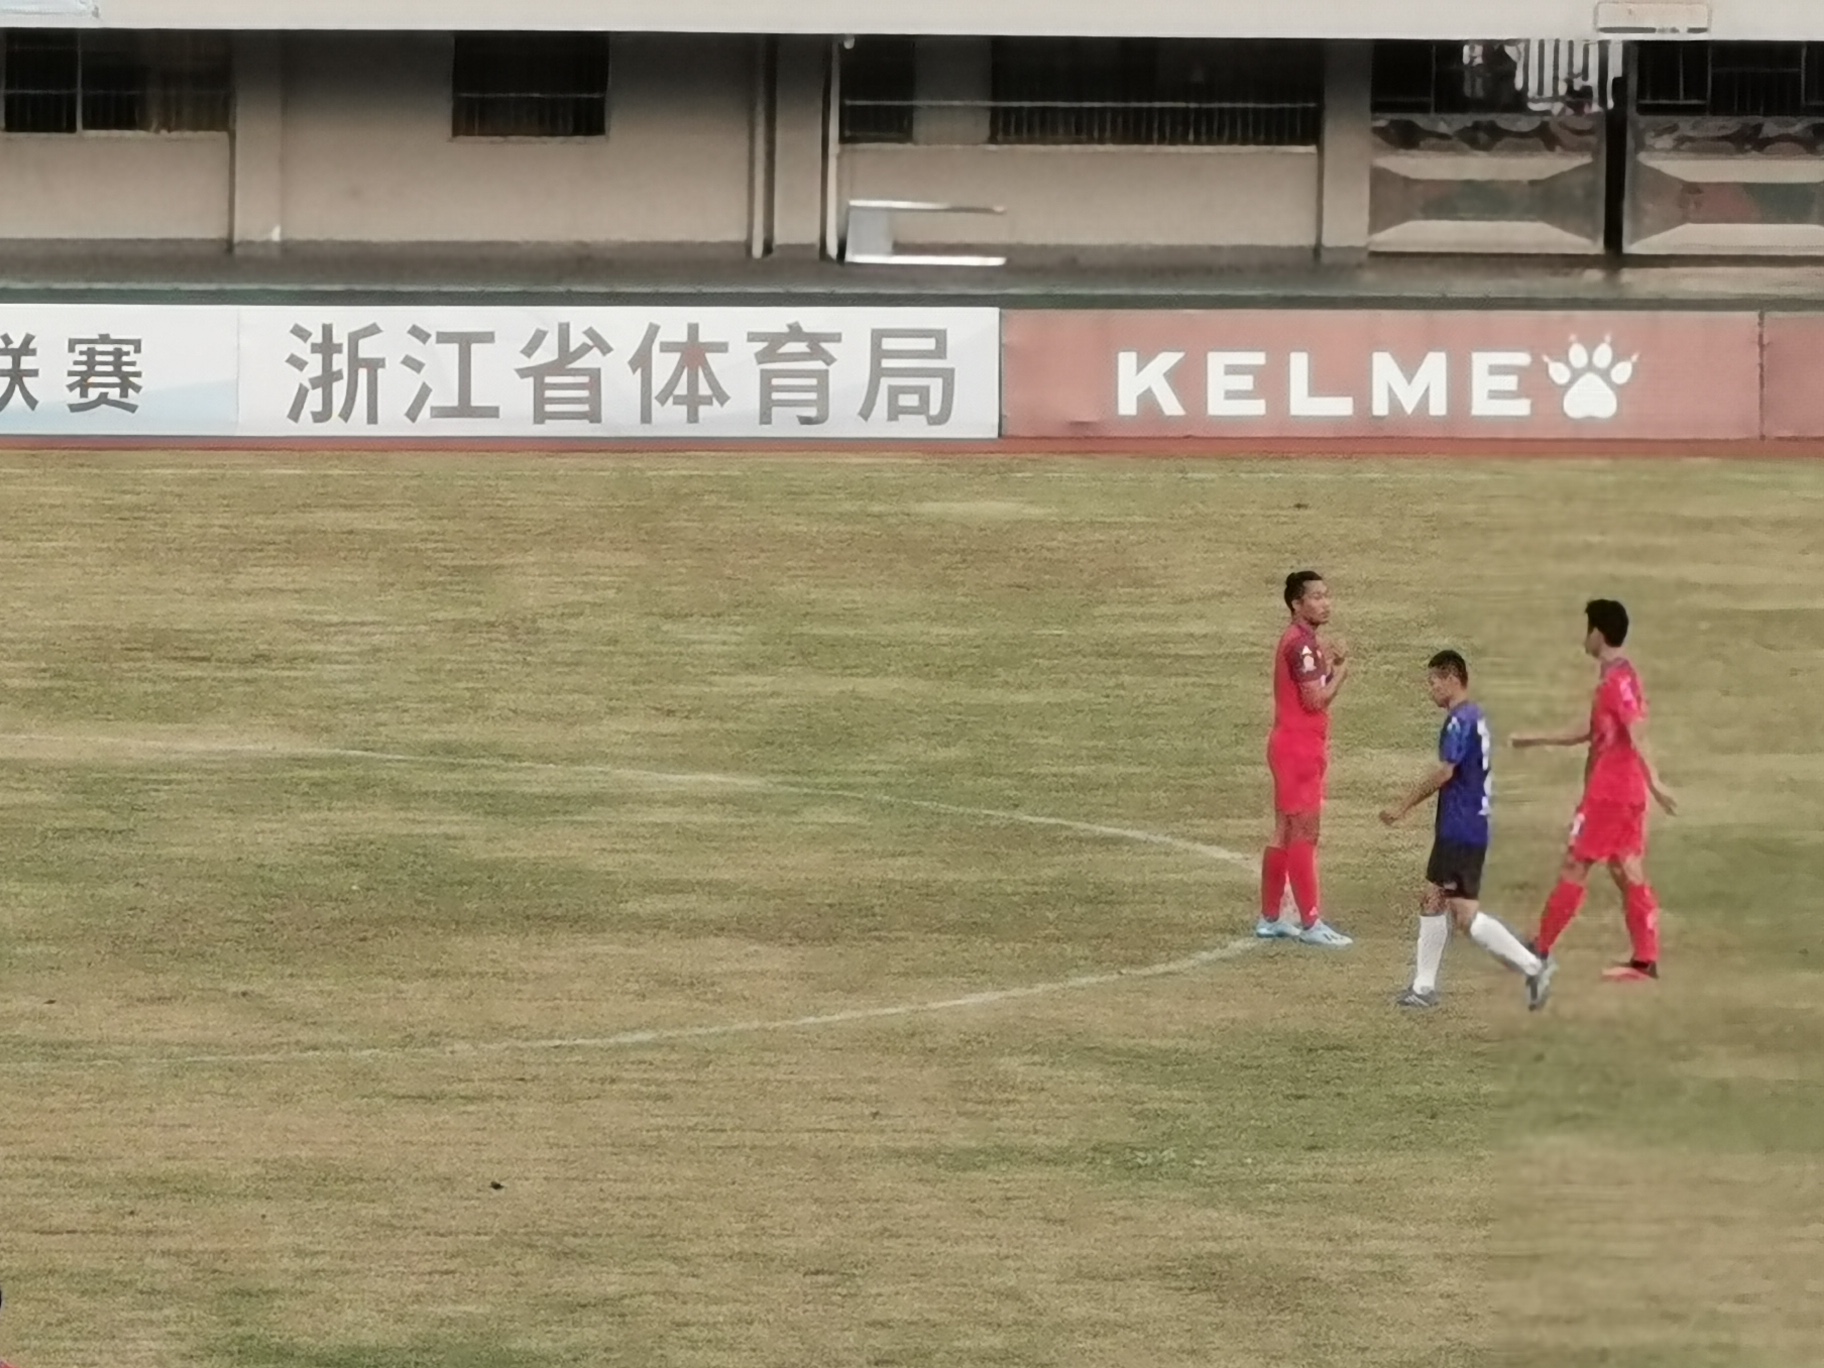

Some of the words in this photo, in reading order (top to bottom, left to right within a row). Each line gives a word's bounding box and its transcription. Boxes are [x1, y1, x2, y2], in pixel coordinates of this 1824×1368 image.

[284, 320, 957, 426] 浙江省体育局
[1117, 350, 1532, 416] KELME
